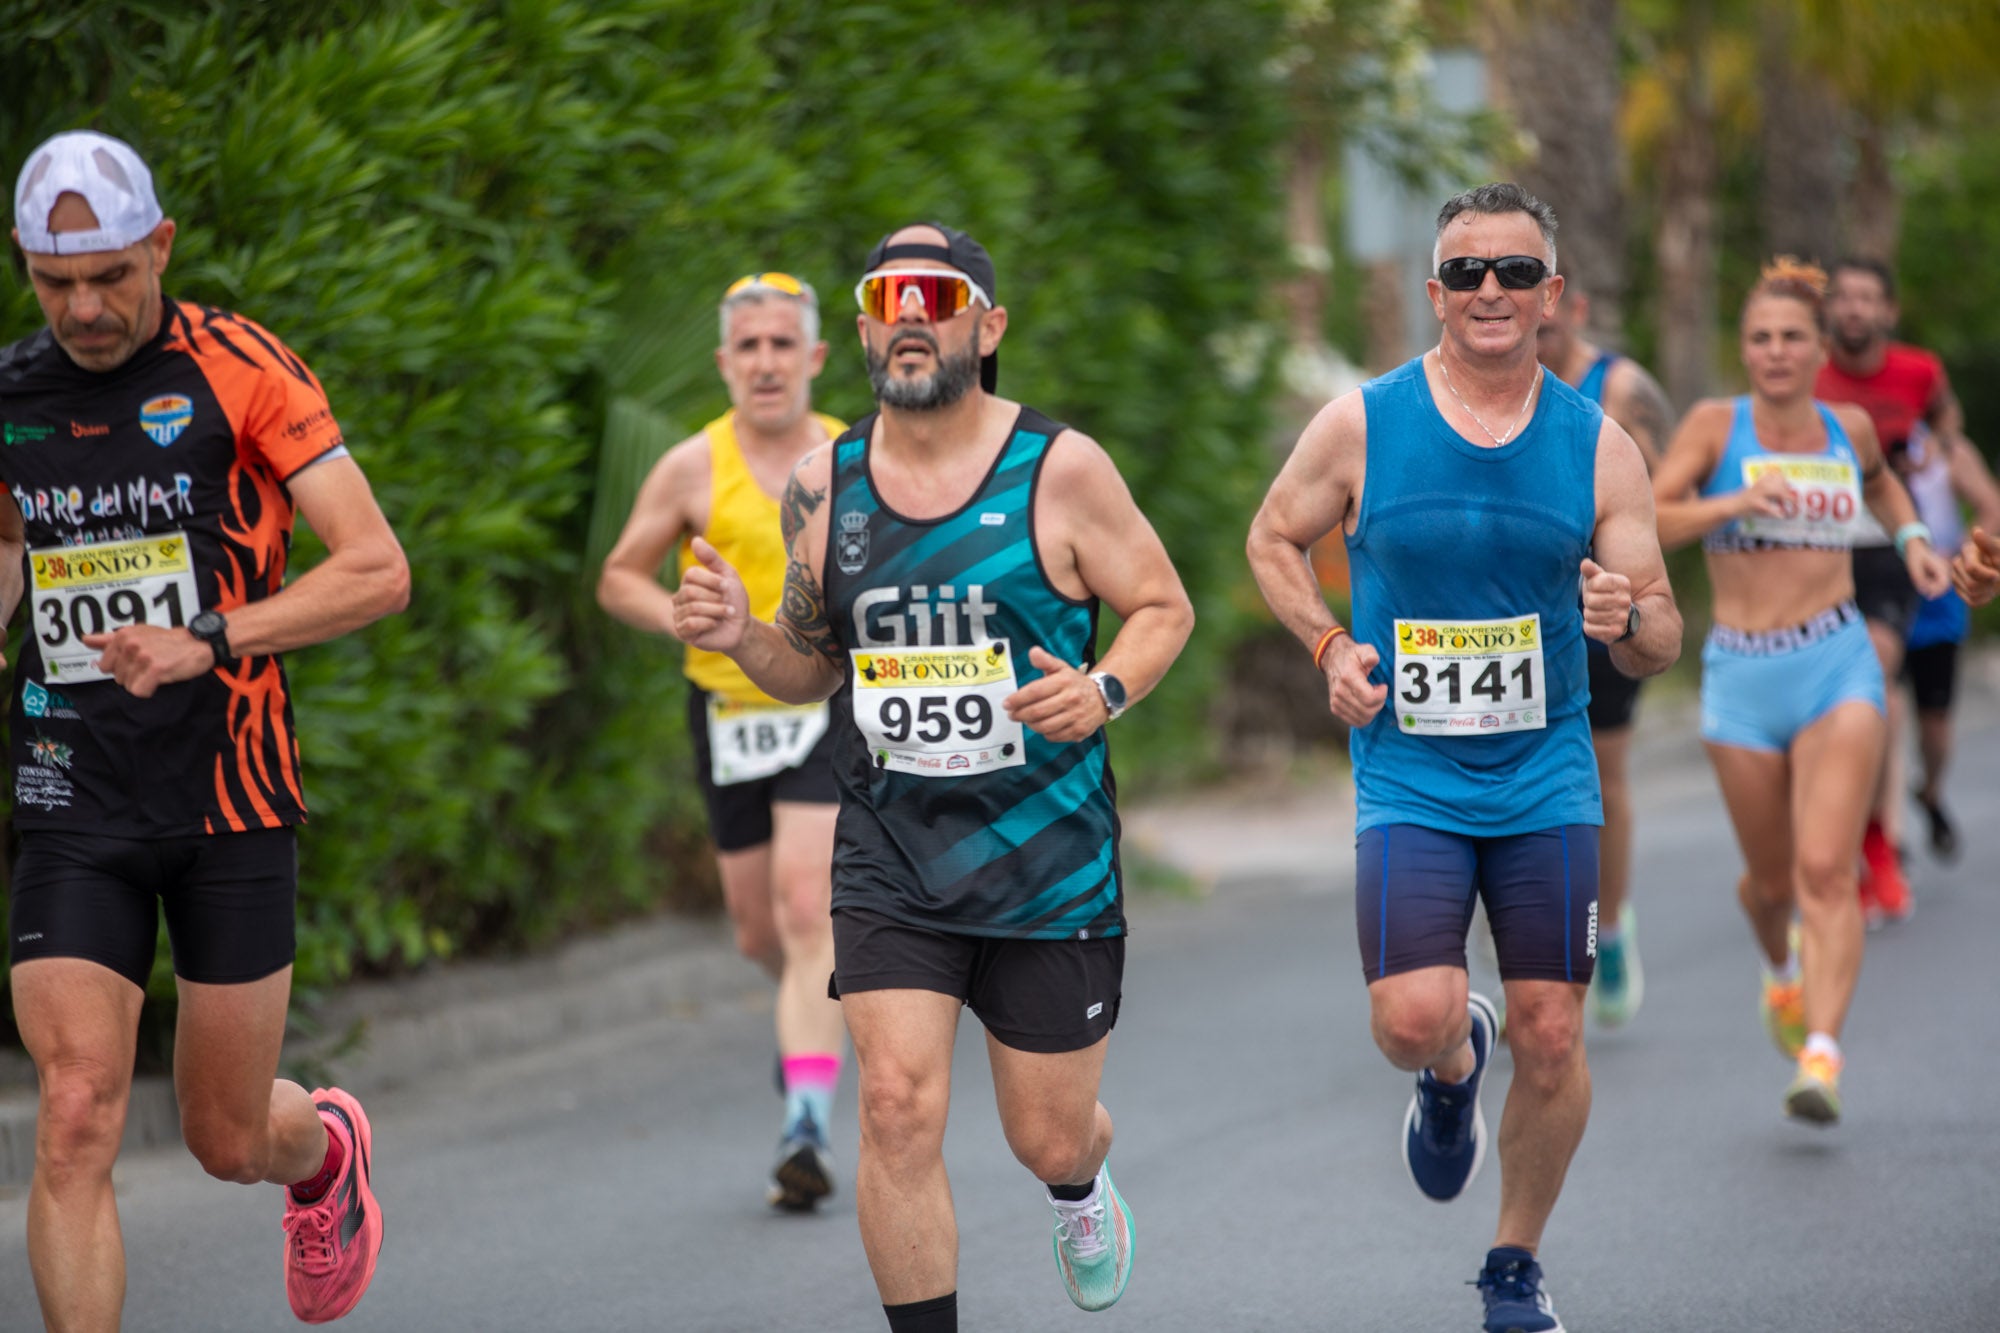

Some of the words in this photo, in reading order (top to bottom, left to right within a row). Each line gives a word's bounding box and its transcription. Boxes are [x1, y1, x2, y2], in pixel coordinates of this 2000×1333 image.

[90, 482, 122, 518] del
[128, 472, 194, 528] MAR
[69, 549, 96, 562] GRAN
[99, 546, 143, 559] PREMIO
[48, 556, 66, 579] 38
[66, 553, 152, 579] FONDO
[40, 582, 185, 648] 3091
[1415, 628, 1437, 647] 38
[1438, 633, 1515, 648] FONDO
[1443, 627, 1468, 635] GRAN
[1472, 626, 1508, 634] PREMIO
[877, 658, 900, 679] 38
[932, 654, 970, 663] PREMIO
[900, 662, 980, 680] FONDO
[1401, 657, 1533, 704] 3141
[879, 694, 993, 744] 959
[1586, 899, 1599, 960] Joma
